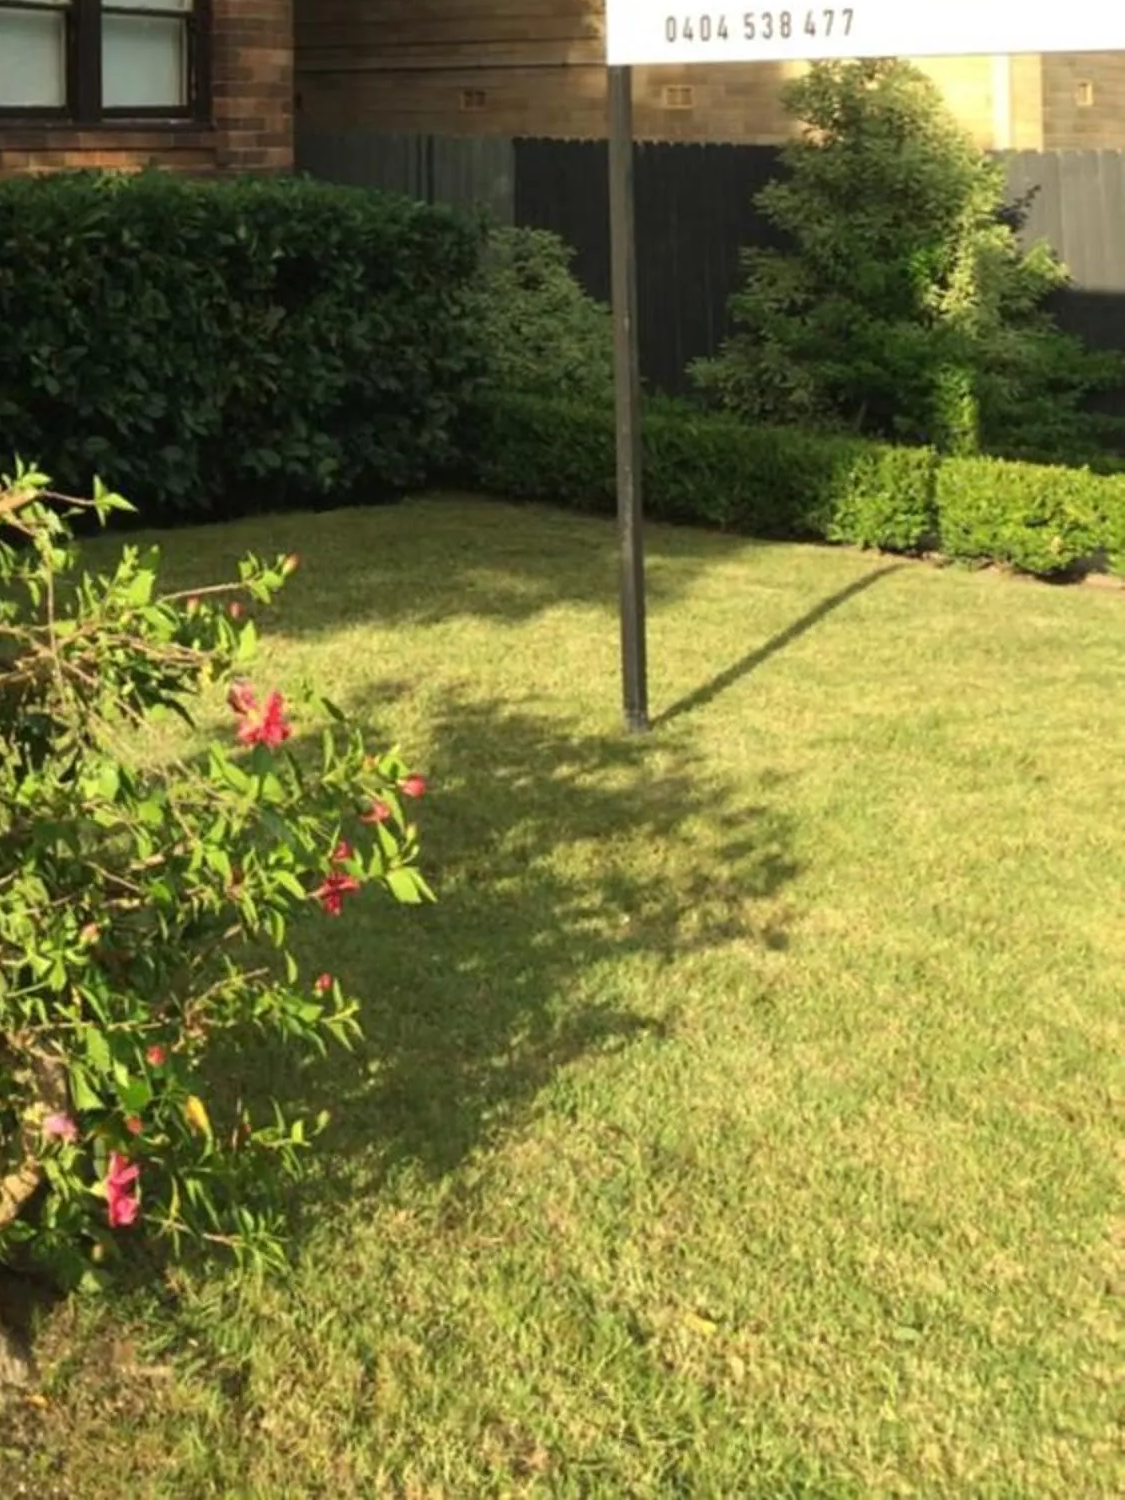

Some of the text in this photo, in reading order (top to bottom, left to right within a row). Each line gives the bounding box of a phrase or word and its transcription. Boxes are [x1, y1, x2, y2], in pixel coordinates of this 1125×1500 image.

[664, 7, 855, 44] 0404 538 477
